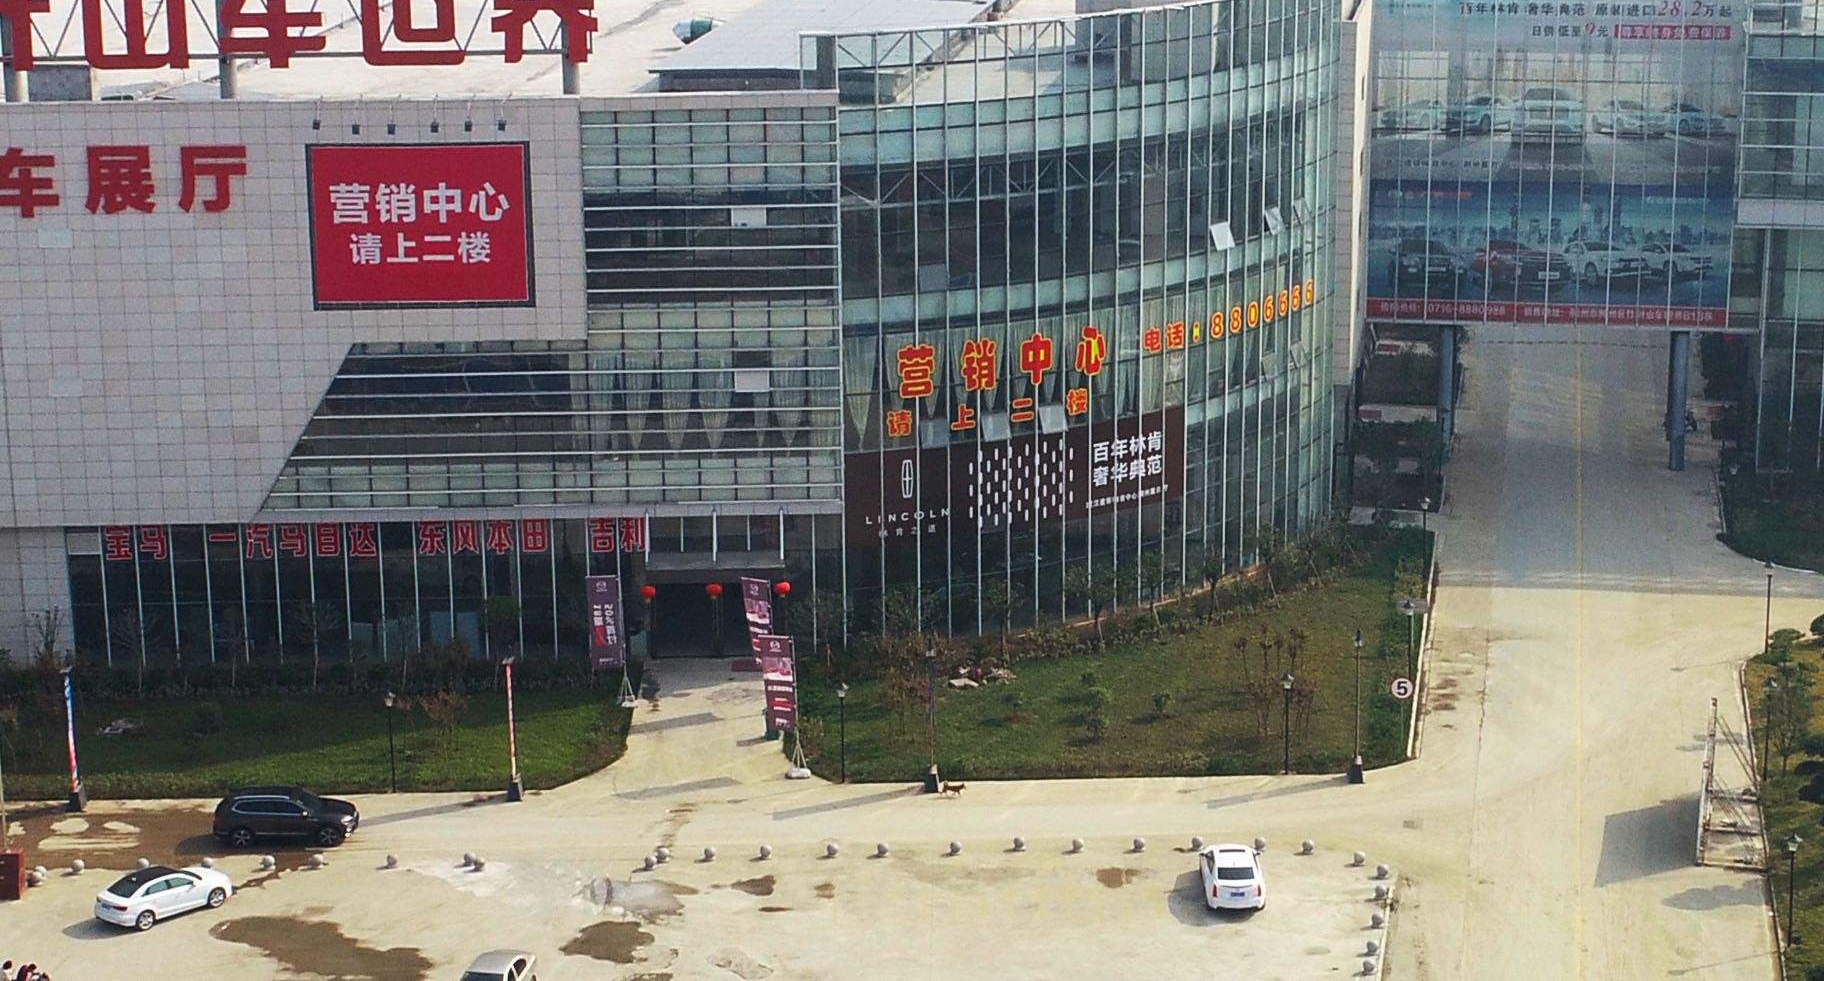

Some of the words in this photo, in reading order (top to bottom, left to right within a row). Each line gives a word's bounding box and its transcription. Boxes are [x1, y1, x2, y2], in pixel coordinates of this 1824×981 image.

[327, 179, 511, 225] 营销中心
[347, 230, 492, 266] 请上二楼
[898, 325, 1107, 399] 营销中心
[887, 388, 1088, 437] 请上二楼
[1093, 430, 1163, 463] 百年林肯
[1093, 454, 1163, 487] 奢华典范
[865, 508, 950, 525] LINCOLN
[104, 523, 167, 561] 宝马
[209, 521, 377, 558] 一汽马自达
[419, 518, 549, 555] 东风本田
[589, 517, 648, 554] 吉利
